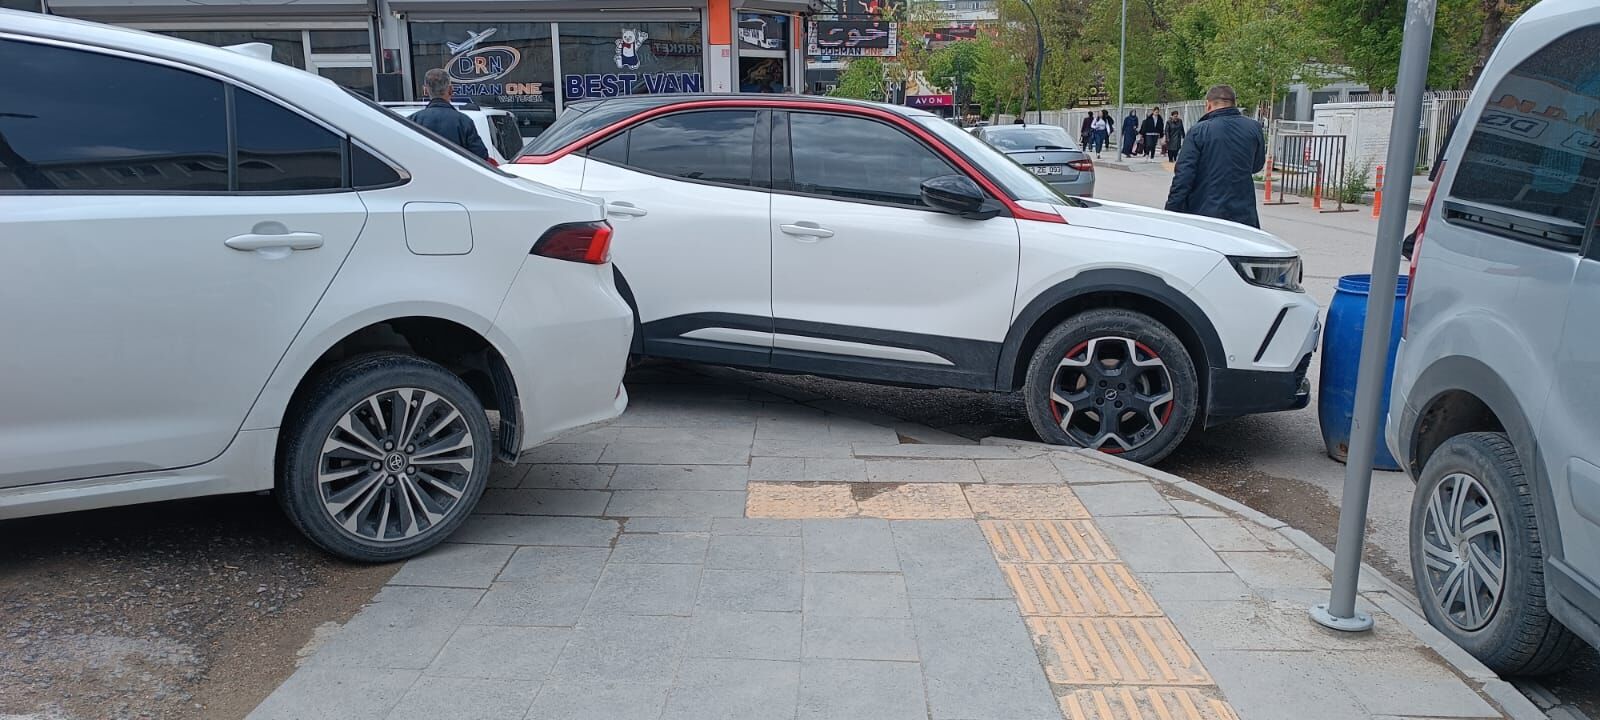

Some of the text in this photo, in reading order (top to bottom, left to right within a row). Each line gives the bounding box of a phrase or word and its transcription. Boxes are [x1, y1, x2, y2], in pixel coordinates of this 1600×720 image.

[458, 55, 503, 75] DRN
[505, 82, 543, 95] ONE
[565, 73, 701, 98] BEST VAN
